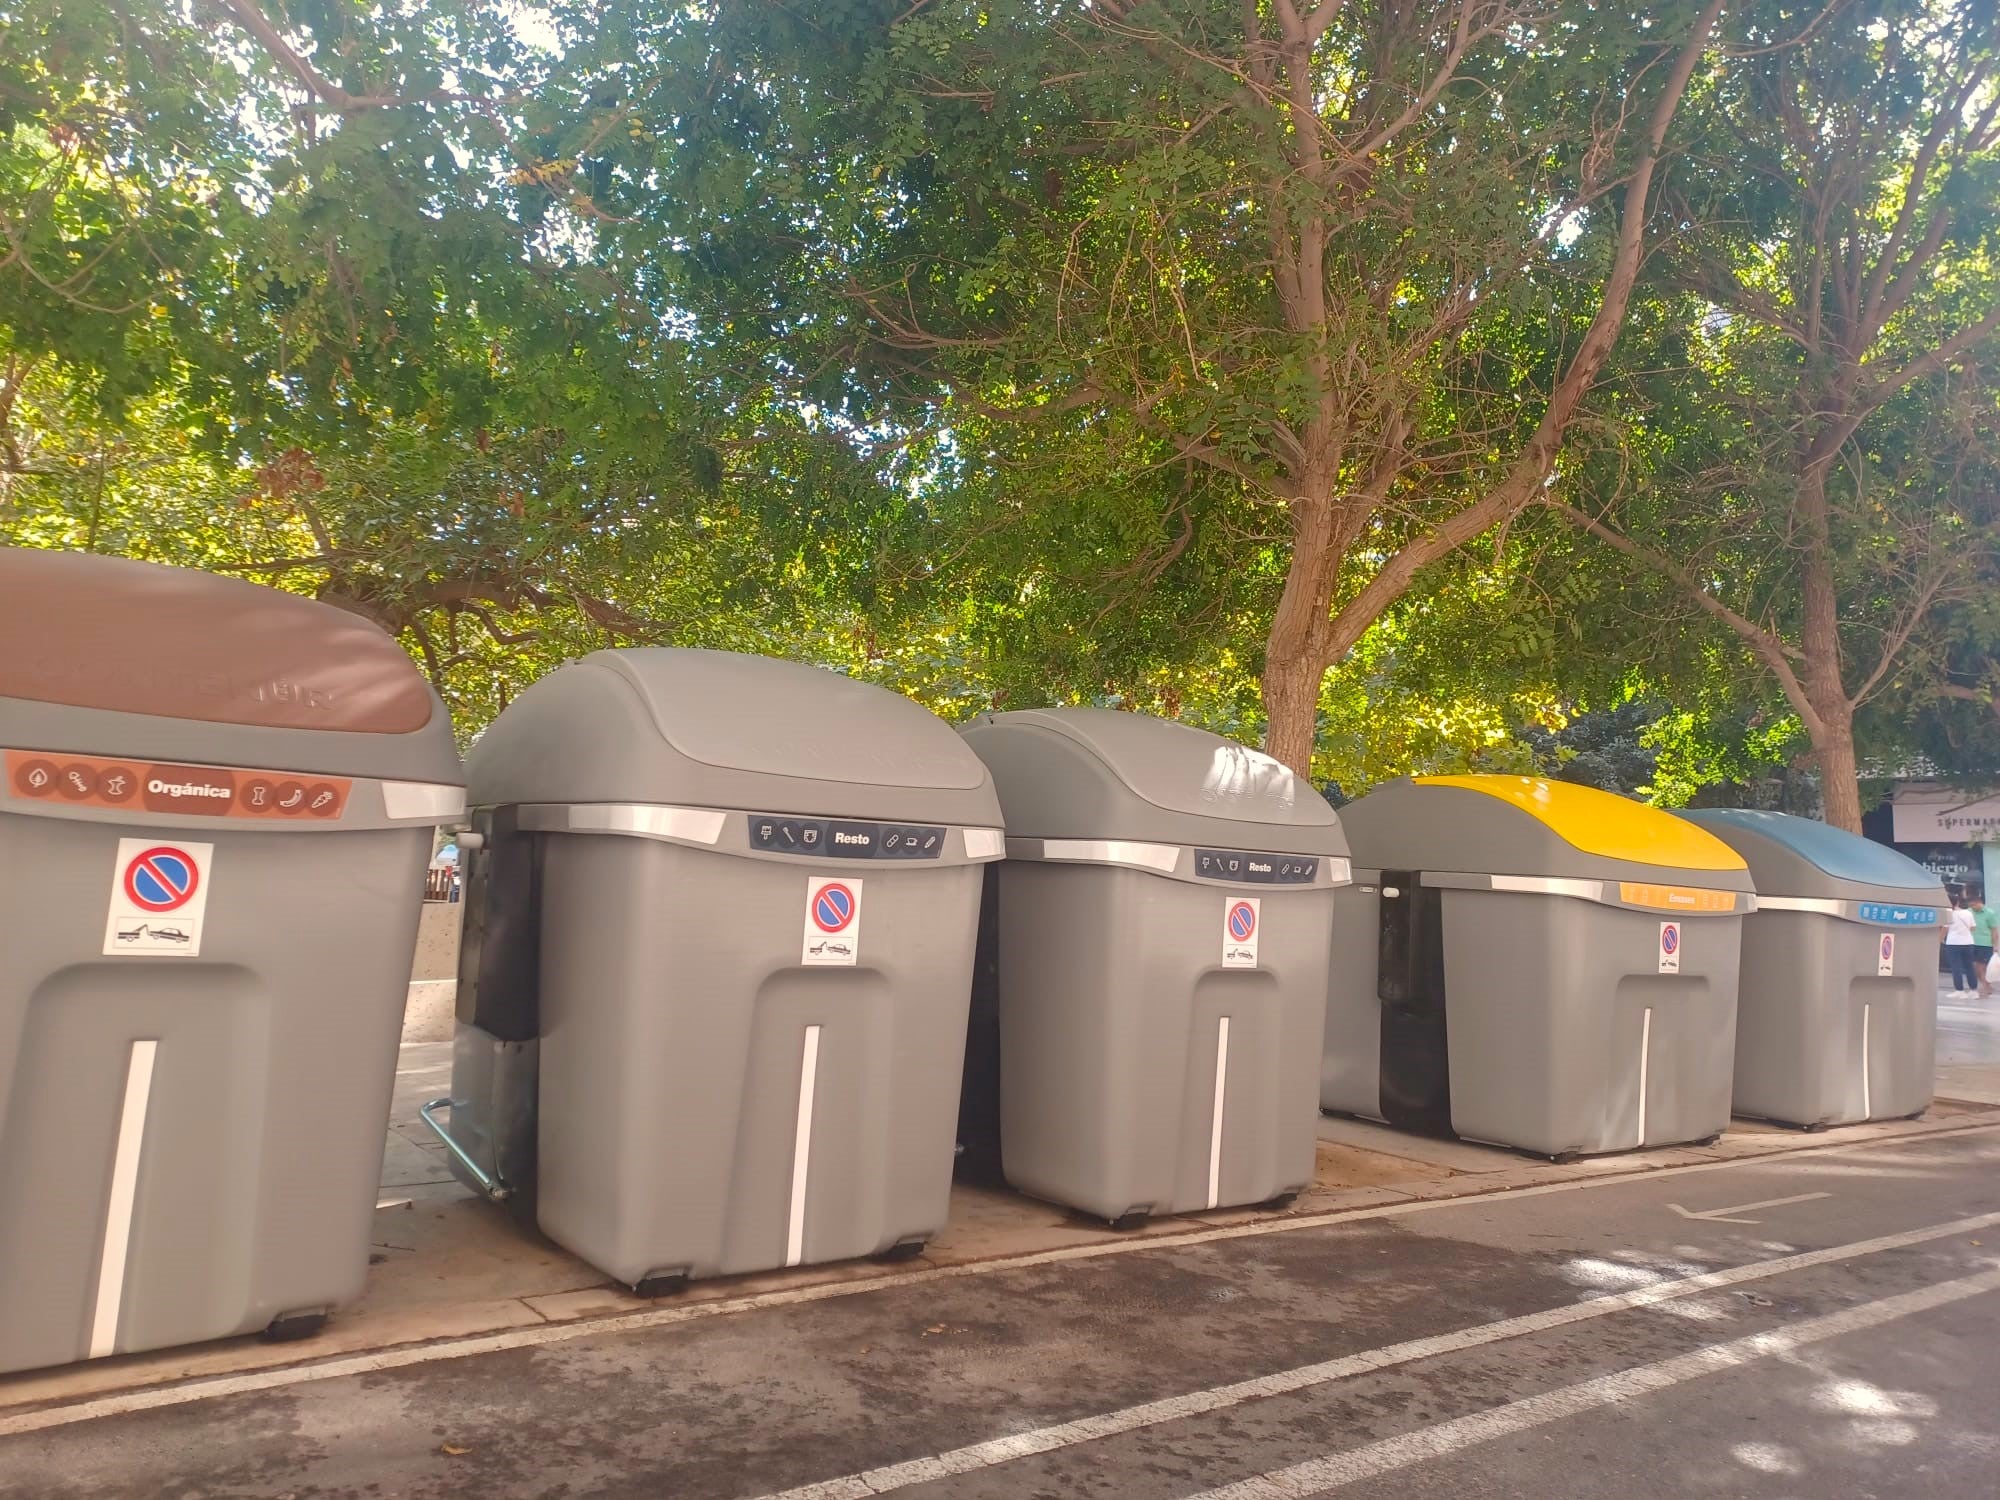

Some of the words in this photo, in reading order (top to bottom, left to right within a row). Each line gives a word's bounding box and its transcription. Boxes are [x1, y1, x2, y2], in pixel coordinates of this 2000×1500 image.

[147, 779, 232, 799] Orgánica
[834, 832, 870, 845] Resto
[1248, 862, 1272, 873] Resto
[1921, 862, 1969, 873] bierto
